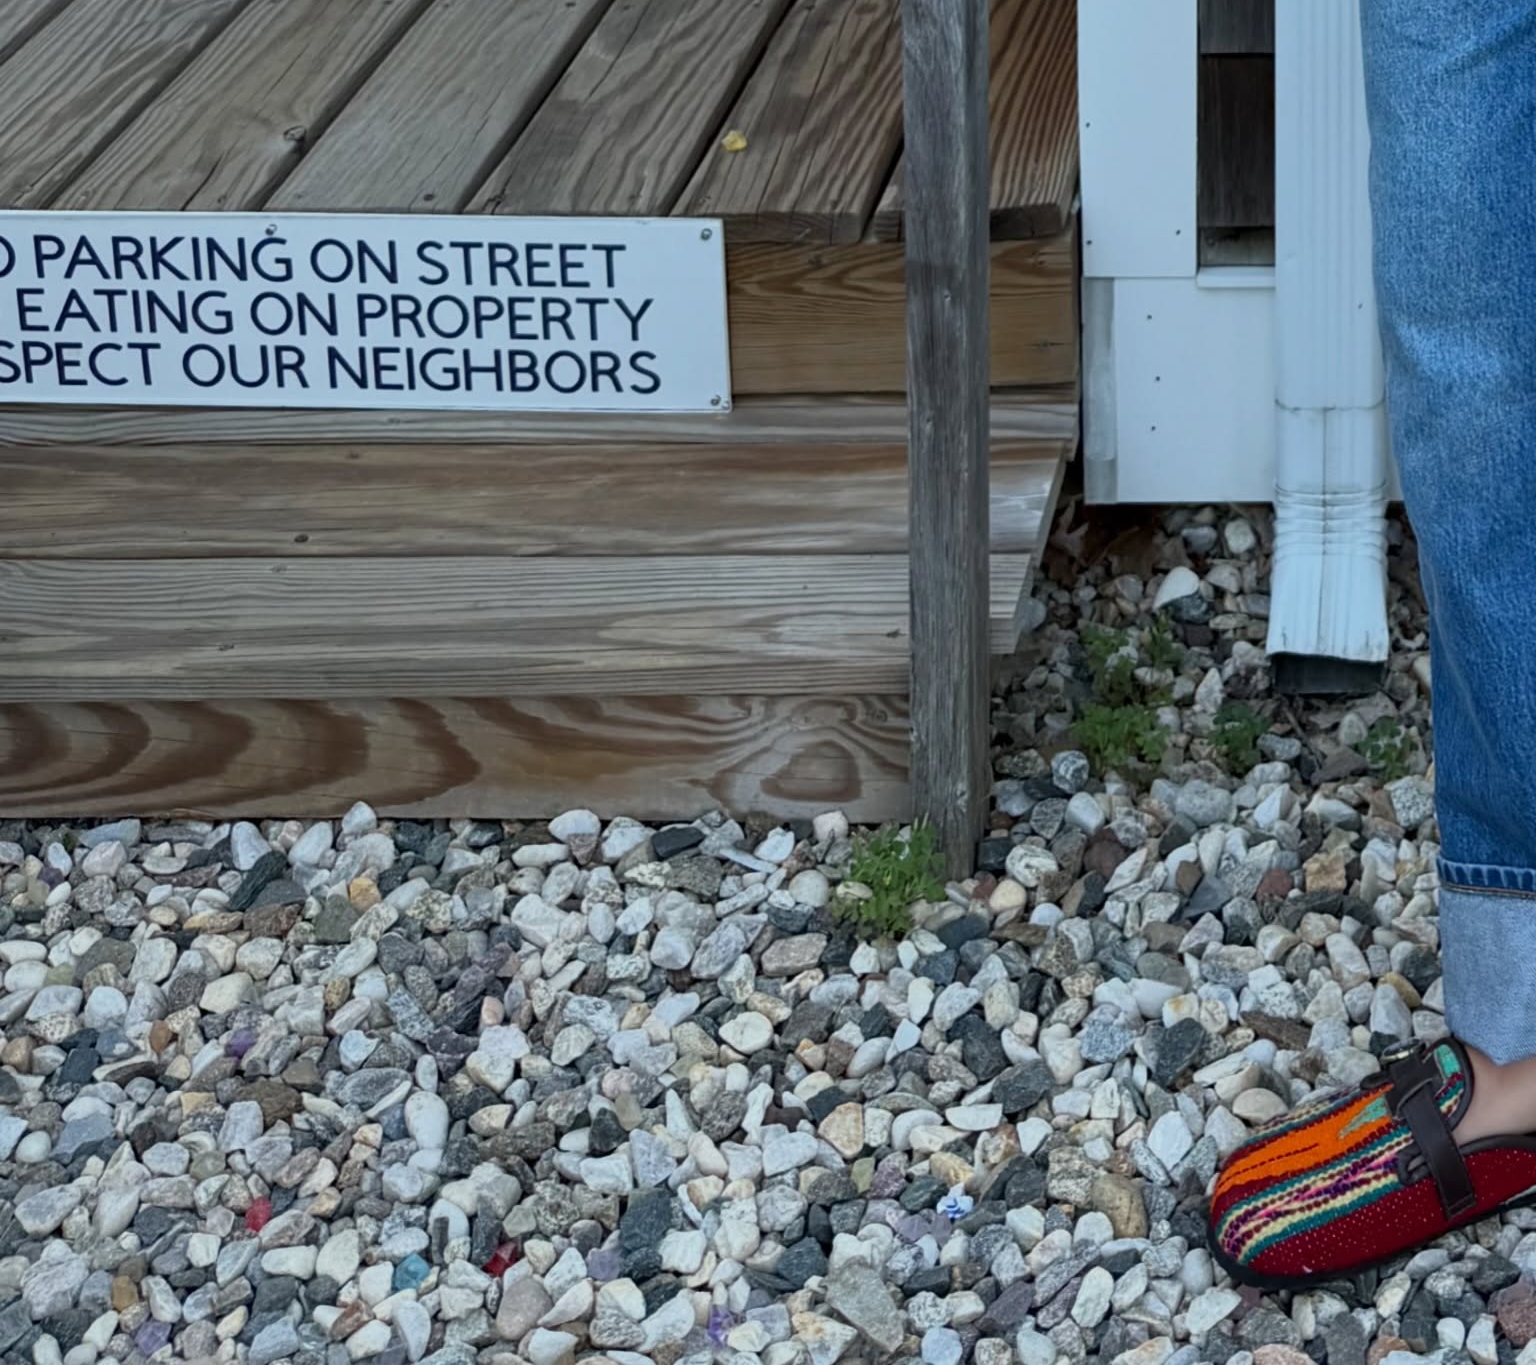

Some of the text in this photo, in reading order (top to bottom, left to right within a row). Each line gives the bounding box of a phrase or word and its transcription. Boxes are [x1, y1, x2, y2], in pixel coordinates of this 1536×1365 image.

[32, 234, 293, 283] PARKING
[309, 238, 399, 285] ON
[416, 240, 628, 289] STREET
[15, 287, 655, 342] EATING ON PROPERTY
[182, 343, 310, 389] OUR
[327, 345, 662, 395] NEIGHBORS
